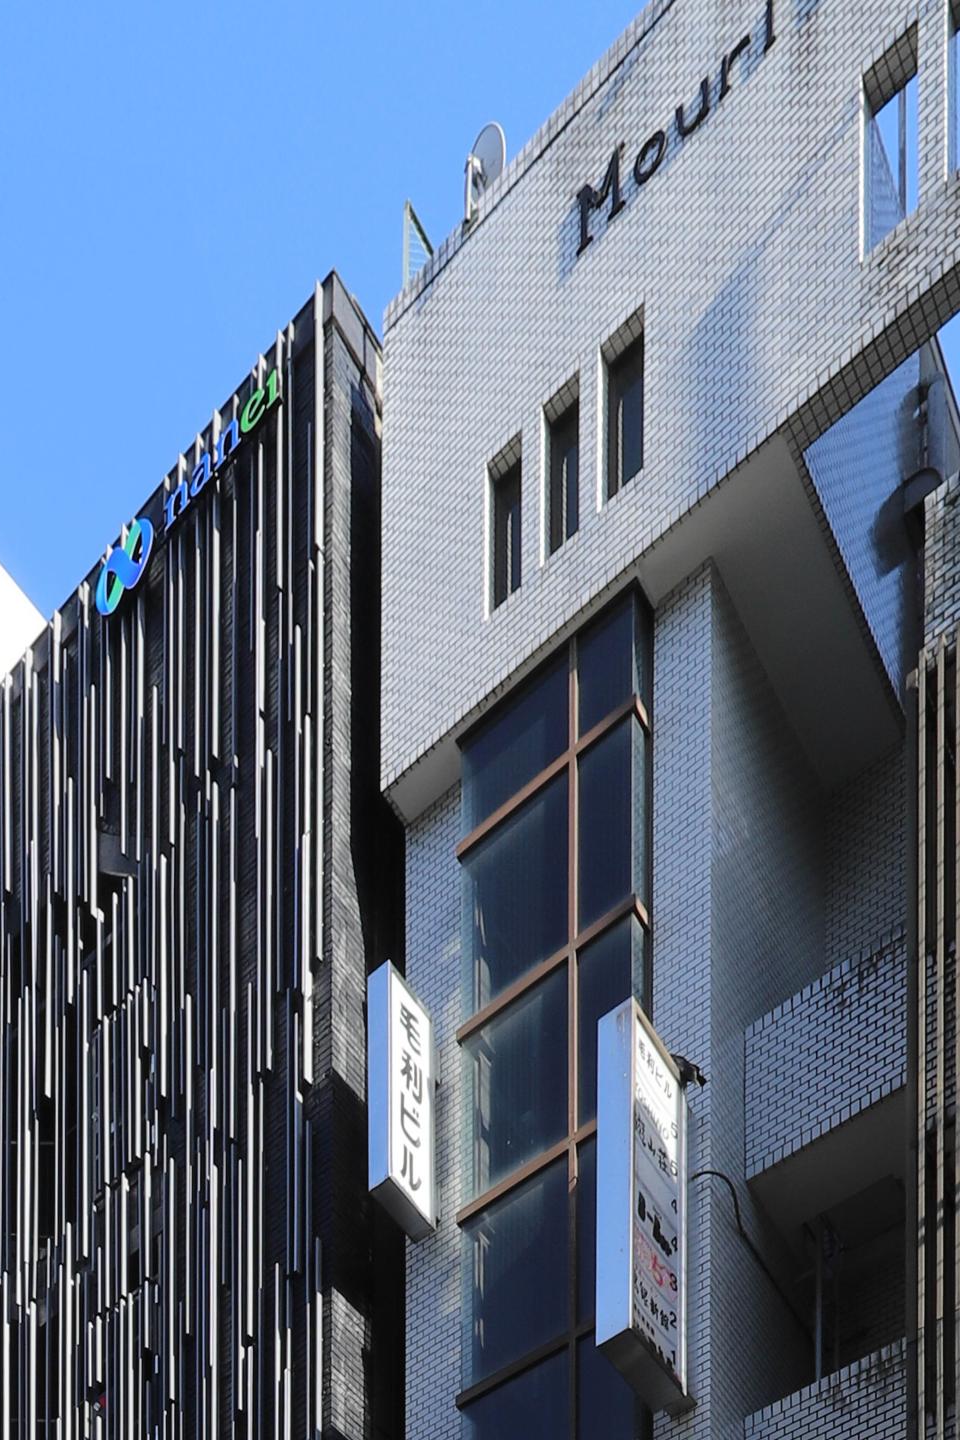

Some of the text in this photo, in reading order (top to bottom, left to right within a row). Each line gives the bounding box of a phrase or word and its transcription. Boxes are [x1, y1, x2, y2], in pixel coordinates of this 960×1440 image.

[398, 998, 424, 1193] 毛利ビル
[670, 1122, 679, 1141] 5
[670, 1160, 679, 1177] 5
[670, 1198, 678, 1215] 4
[670, 1236, 678, 1251] 4
[669, 1272, 678, 1292] 3
[669, 1310, 678, 1329] 2
